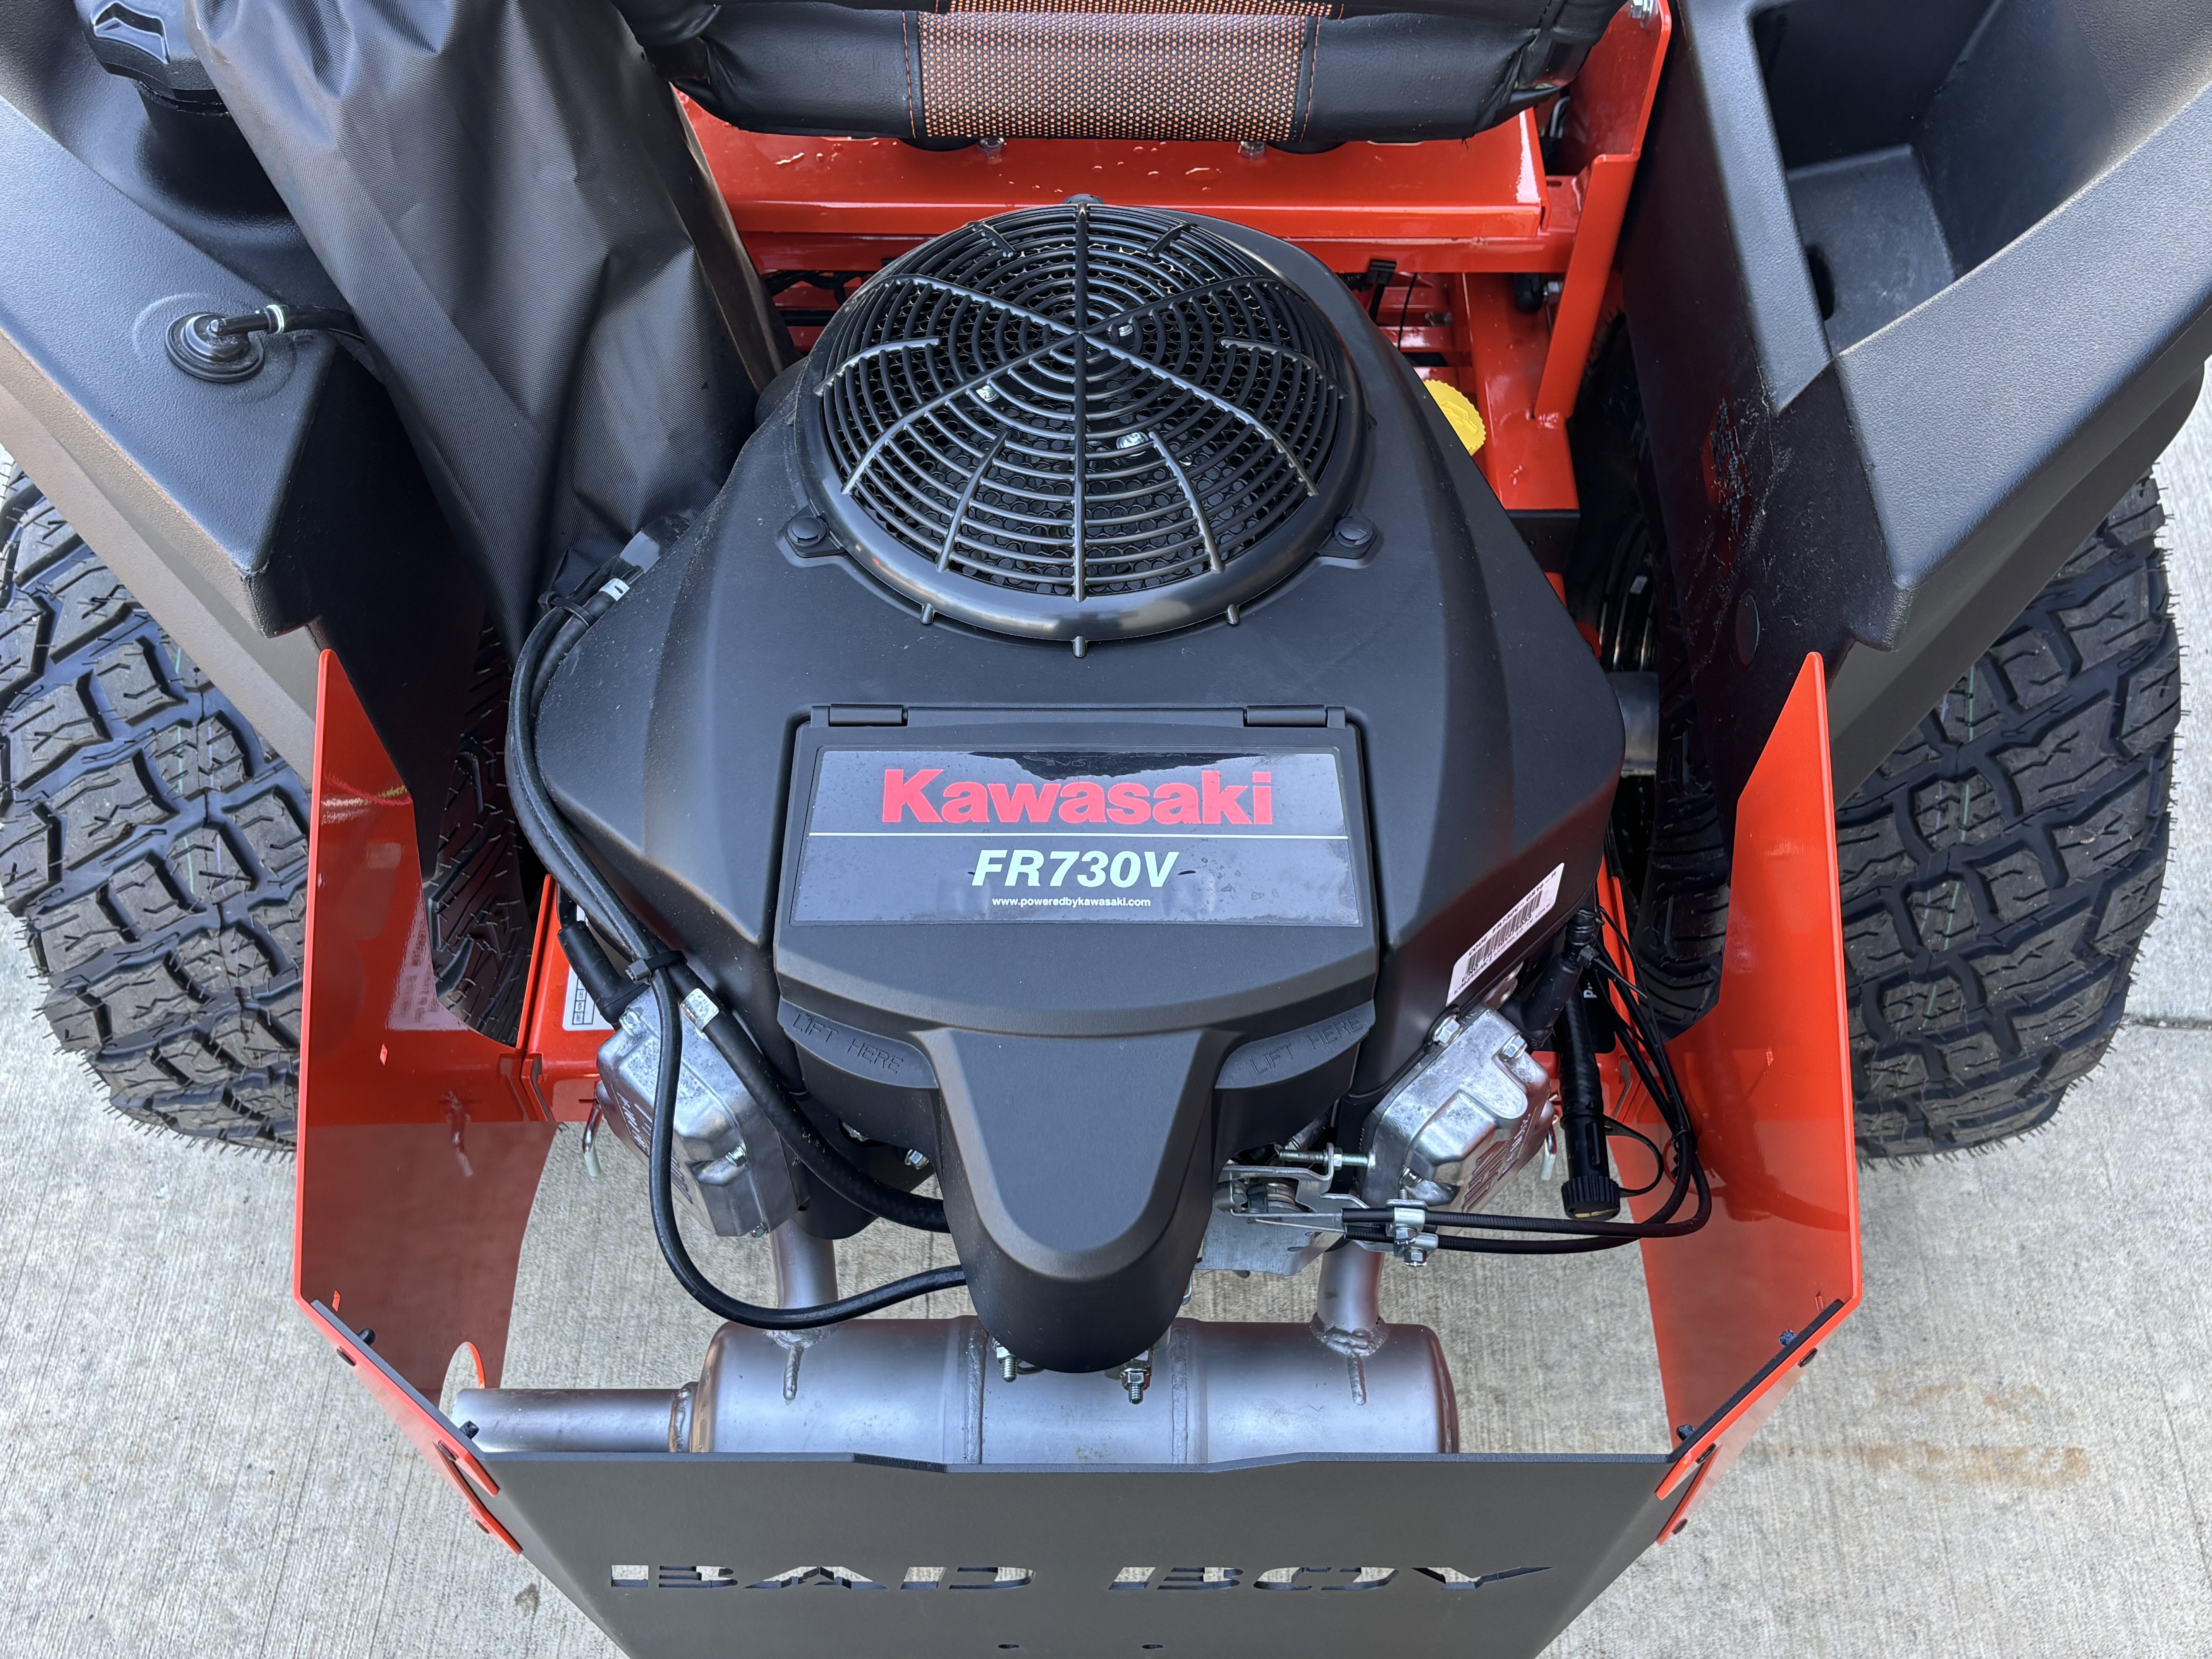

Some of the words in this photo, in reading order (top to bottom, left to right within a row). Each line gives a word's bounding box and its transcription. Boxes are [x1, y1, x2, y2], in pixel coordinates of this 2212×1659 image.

[882, 769, 1273, 825] Kawasaki
[971, 849, 1179, 888] FR730V
[992, 897, 1151, 908] www.poweredbykawasaki.com
[793, 1013, 838, 1043] LIFT
[847, 1038, 904, 1074] HERE
[1250, 1042, 1293, 1074] LIFT
[1306, 1013, 1363, 1051] HERE
[610, 1563, 1036, 1590] BAD
[1108, 1563, 1552, 1590] BOY
